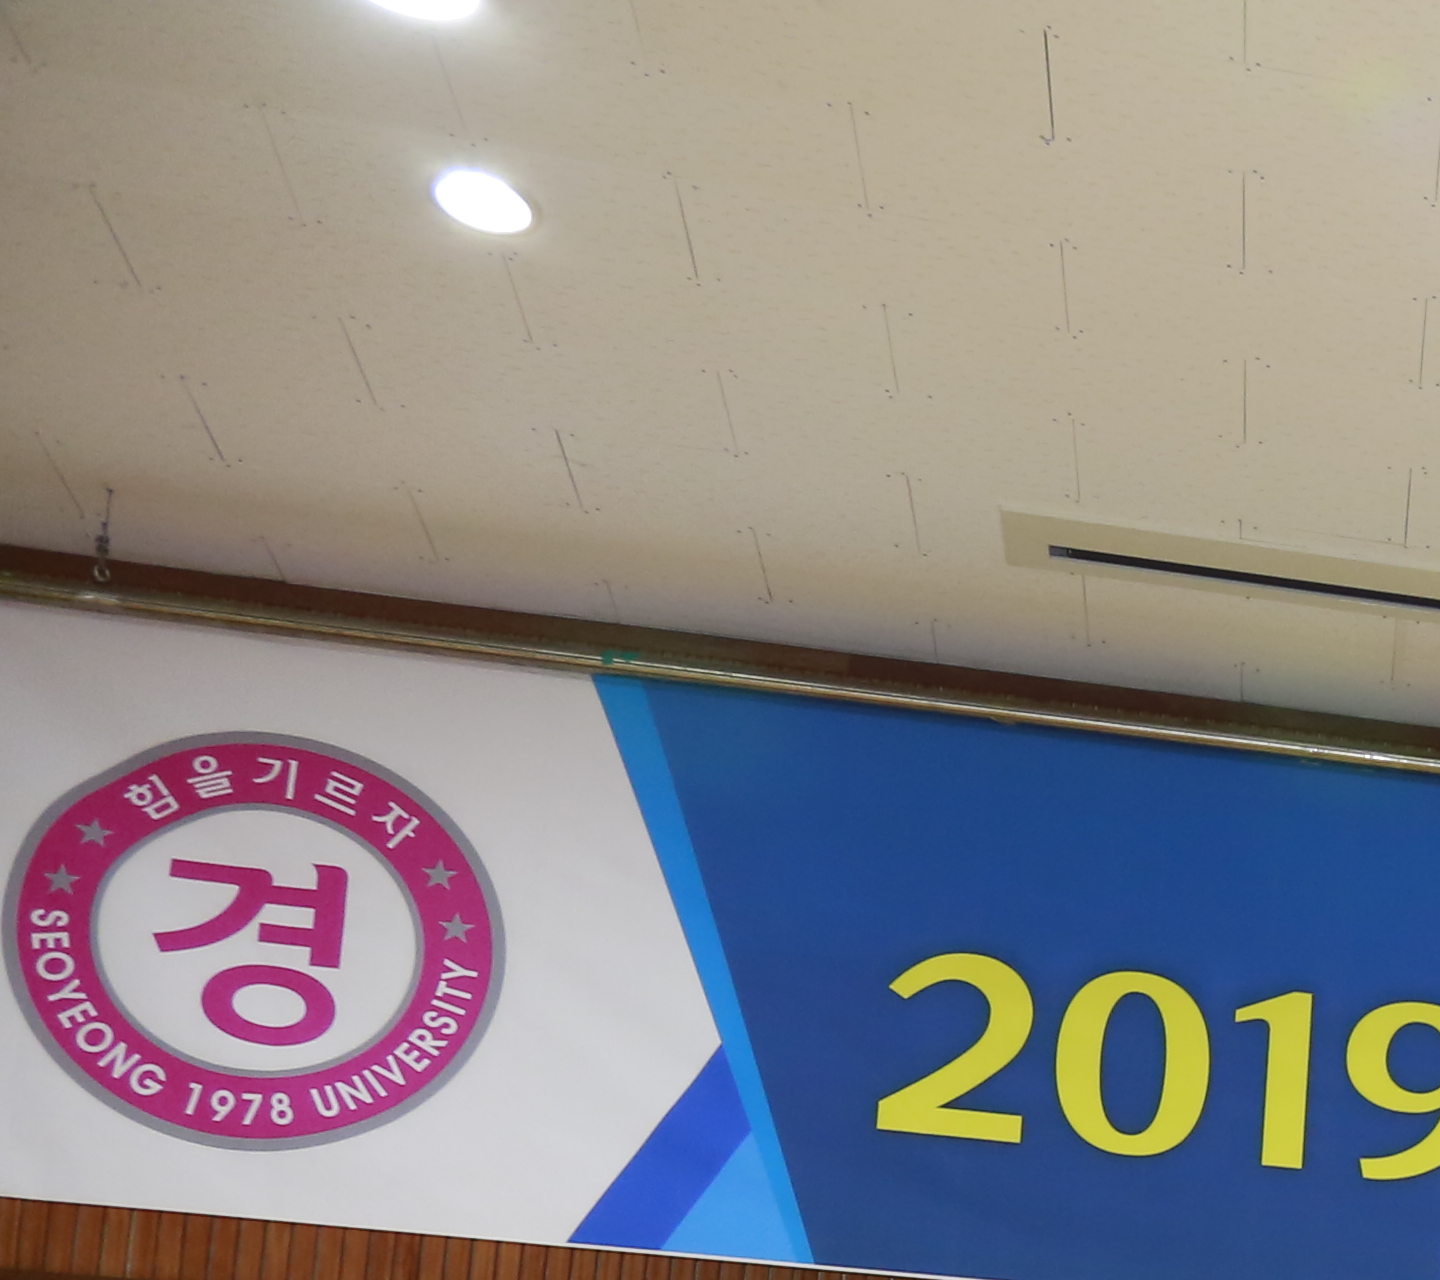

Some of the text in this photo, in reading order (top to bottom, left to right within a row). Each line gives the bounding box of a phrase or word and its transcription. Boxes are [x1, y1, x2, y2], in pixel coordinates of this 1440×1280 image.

[29, 907, 479, 1127] SEOYEONG 1978 UNIVERSITY
[153, 858, 349, 1047] 경
